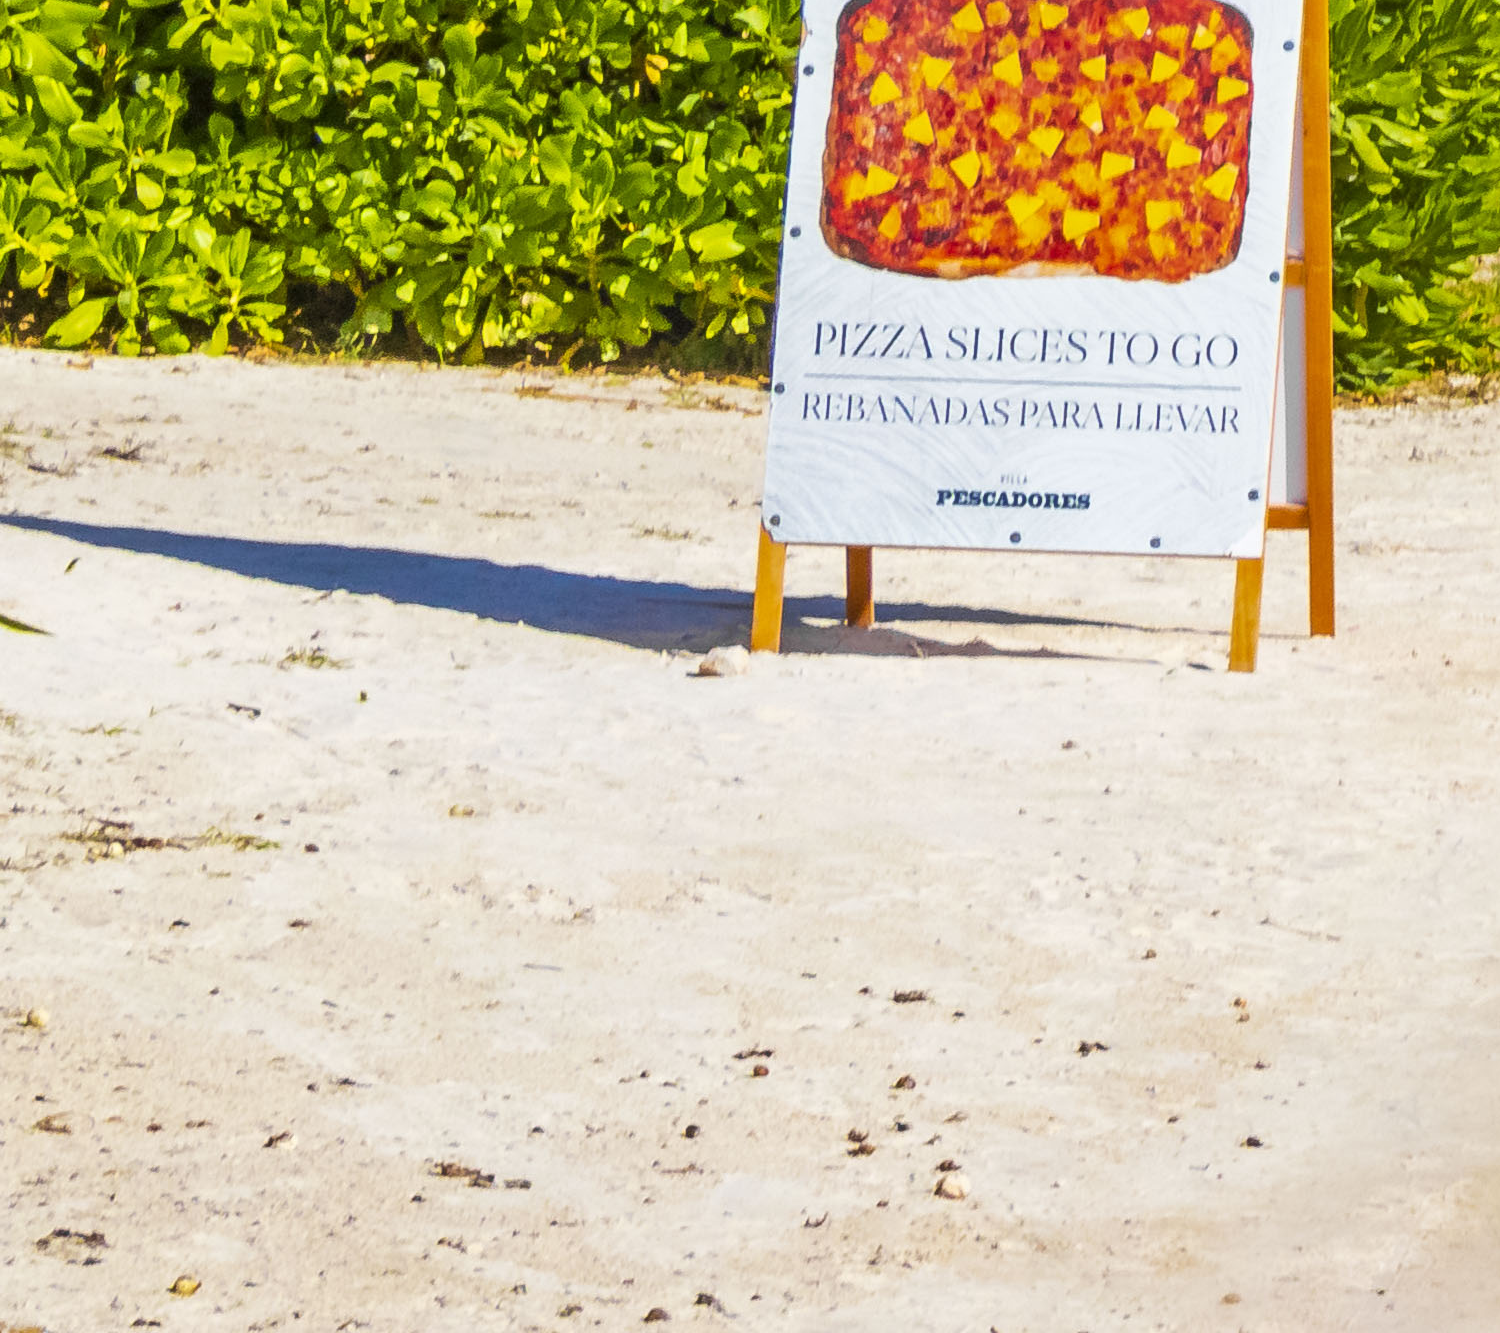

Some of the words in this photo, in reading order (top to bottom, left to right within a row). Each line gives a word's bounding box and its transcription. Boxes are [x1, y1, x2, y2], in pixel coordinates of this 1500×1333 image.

[813, 321, 934, 359] PIZZA
[945, 326, 1088, 365] SLICES
[1099, 330, 1160, 367] TO
[1171, 332, 1240, 369] GO
[801, 392, 1010, 428] REBANADAS
[1019, 400, 1105, 430] PARA
[1115, 403, 1240, 435] LLEVAR
[935, 489, 1092, 510] PESCADORES
